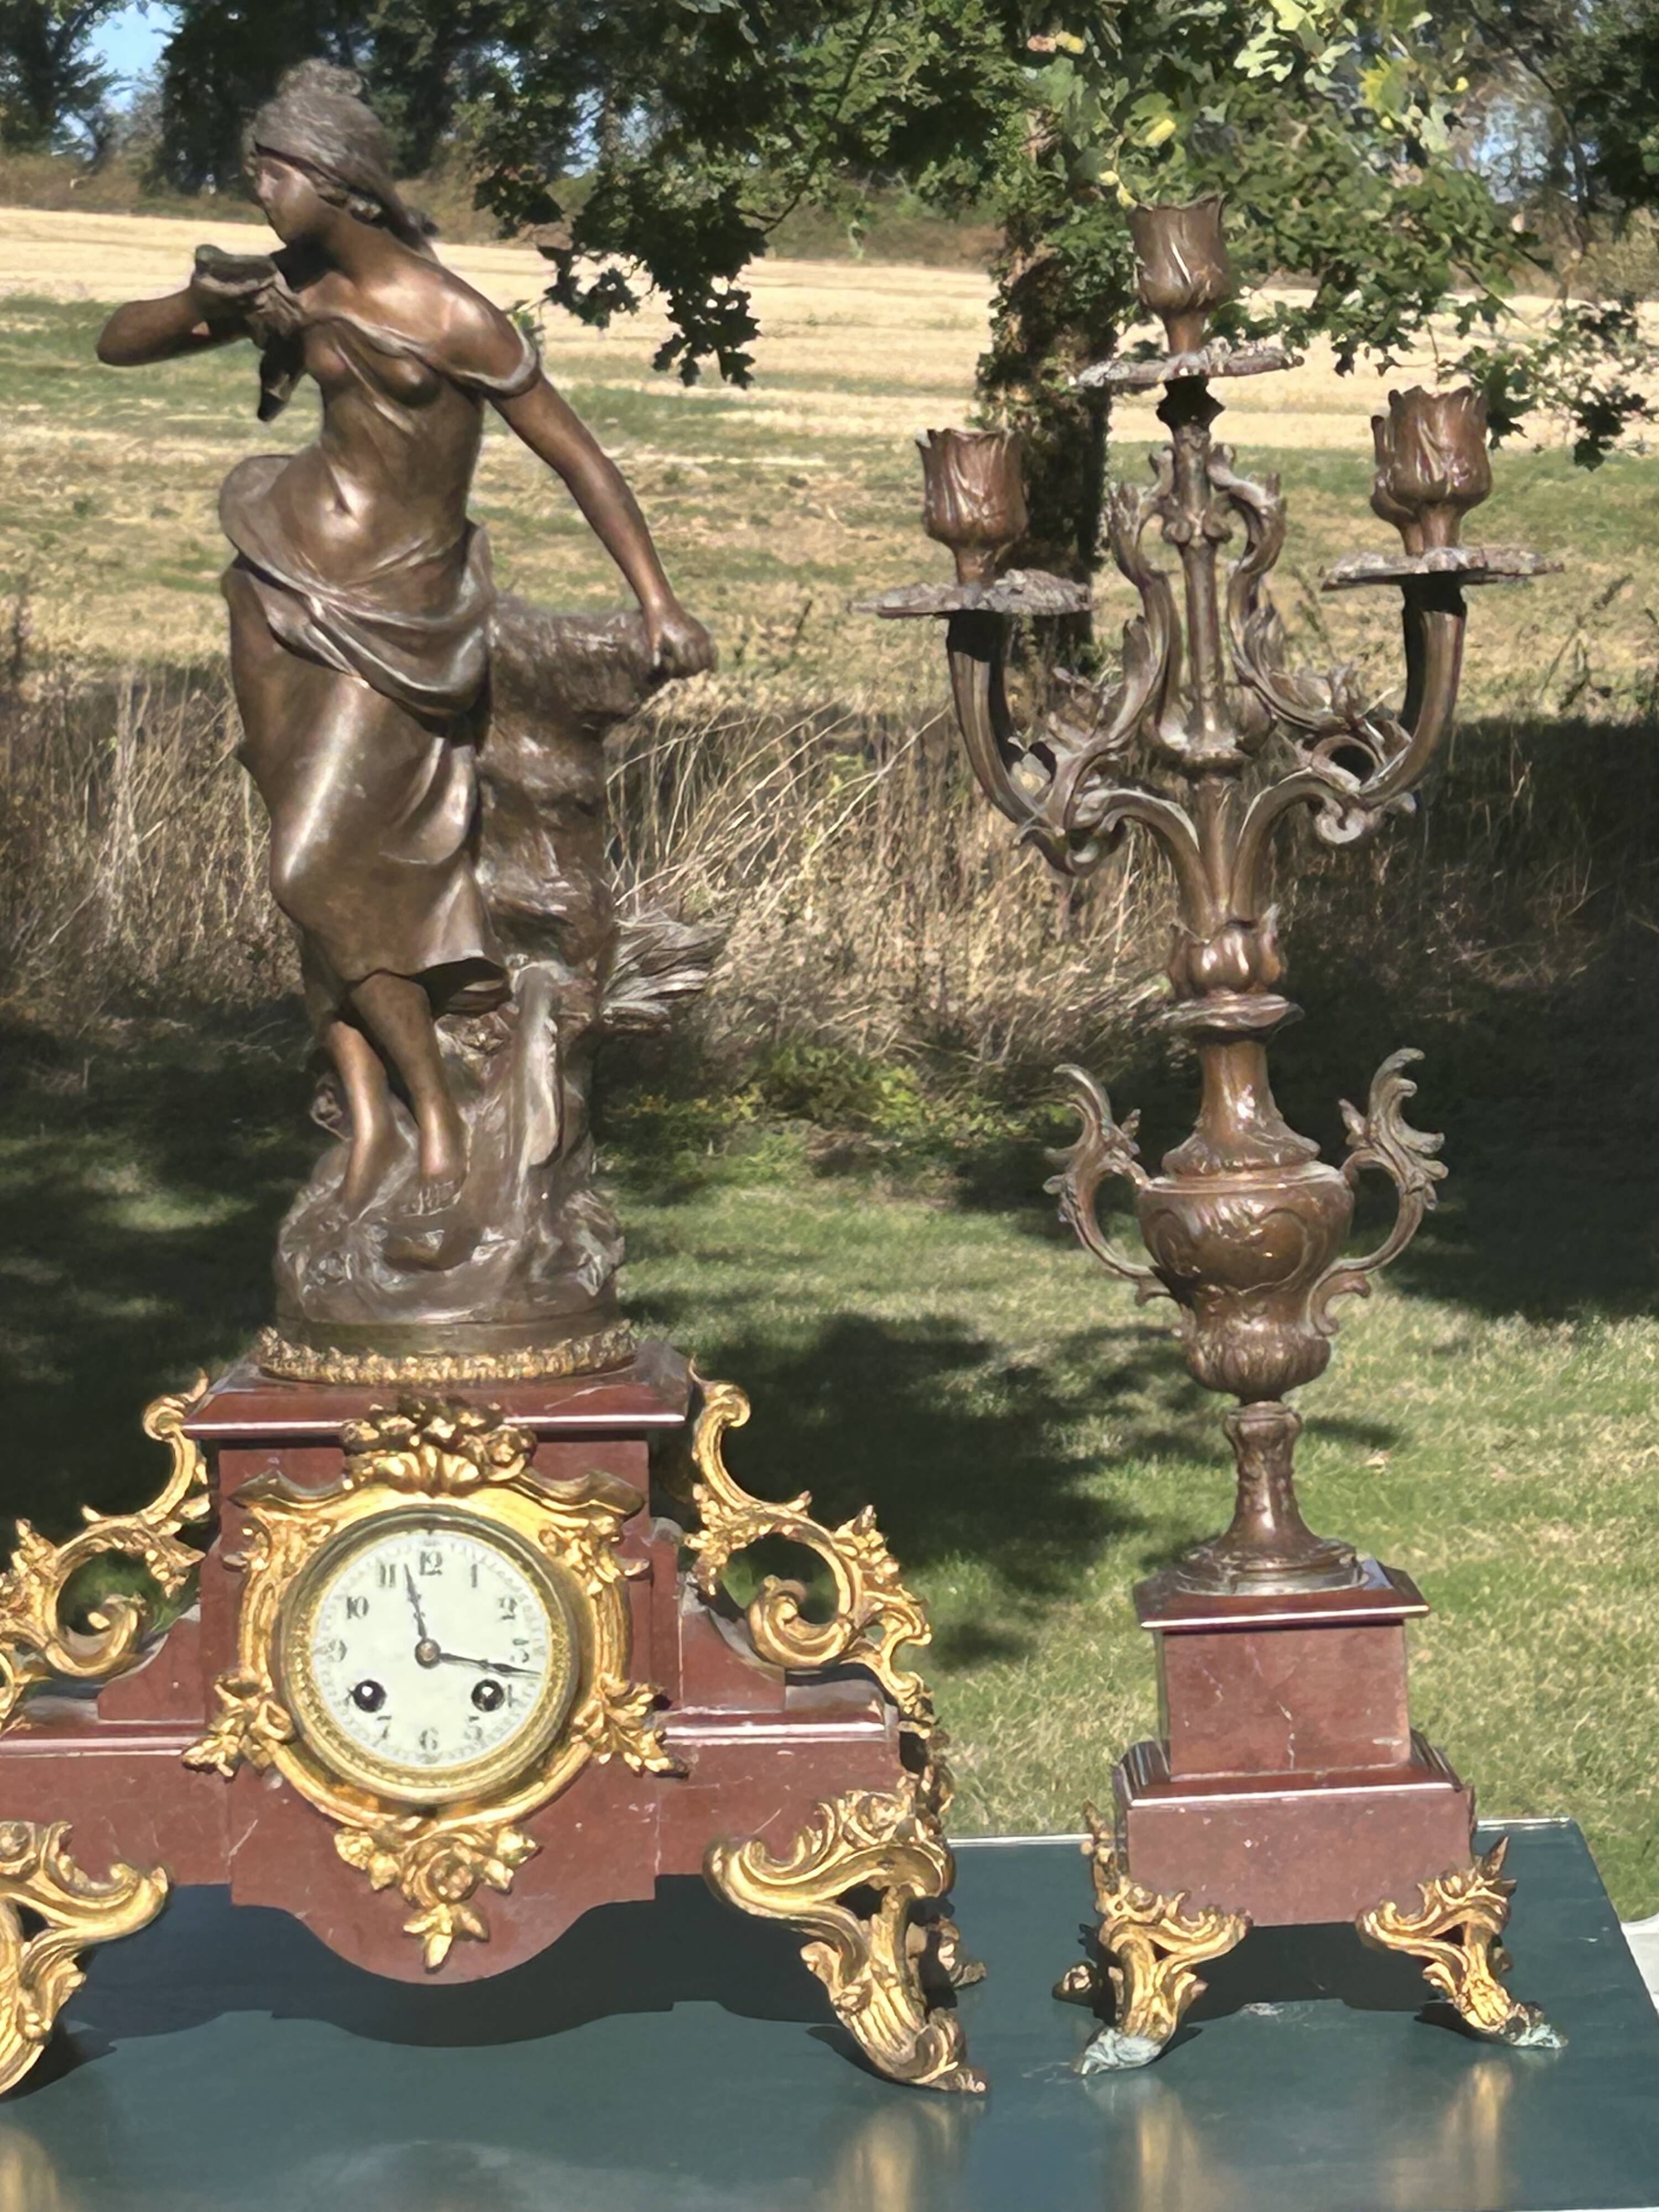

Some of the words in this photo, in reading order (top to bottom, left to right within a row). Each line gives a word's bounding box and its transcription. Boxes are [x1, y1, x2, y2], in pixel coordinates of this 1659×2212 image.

[419, 1551, 442, 1575] 12
[378, 1563, 397, 1588] 11
[471, 1564, 477, 1588] 1
[347, 1595, 369, 1620] 10
[500, 1597, 518, 1621] 2
[327, 1639, 347, 1662] 9
[373, 1715, 392, 1745] 7
[419, 1728, 439, 1750] 6
[465, 1716, 482, 1740] 5
